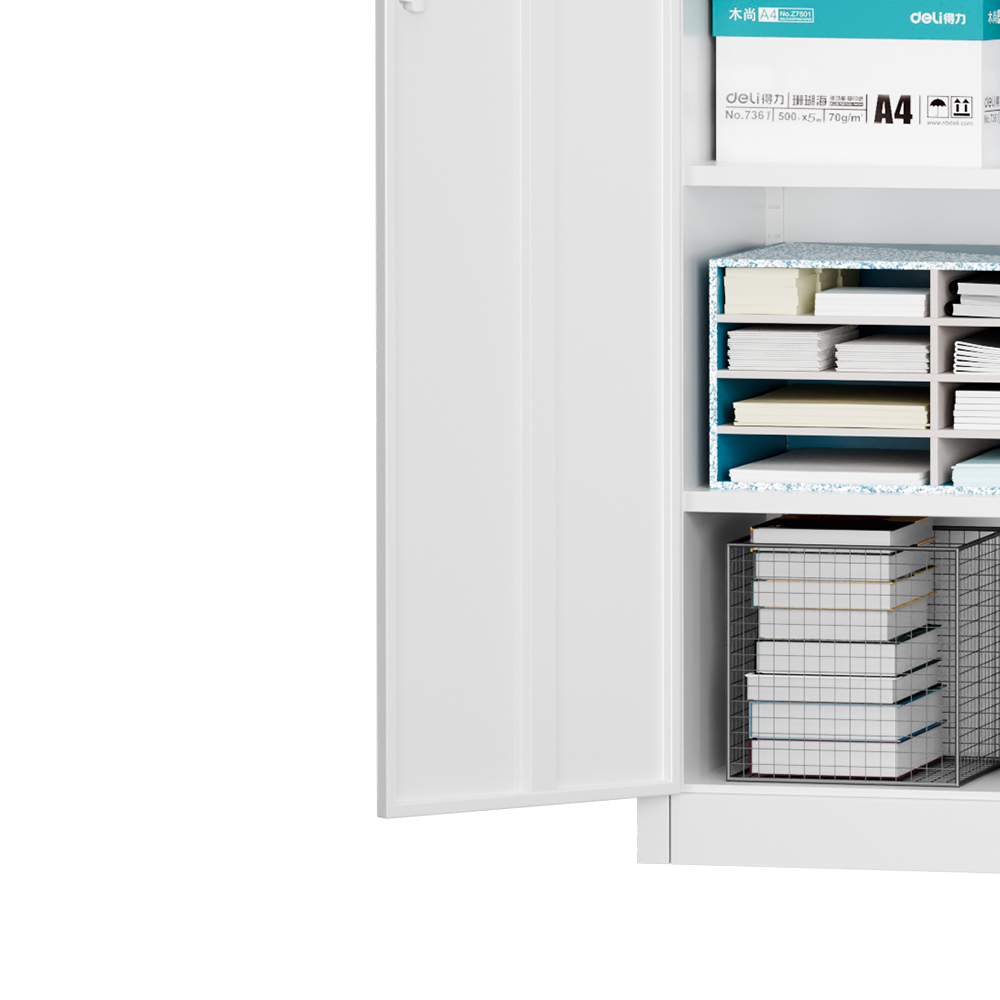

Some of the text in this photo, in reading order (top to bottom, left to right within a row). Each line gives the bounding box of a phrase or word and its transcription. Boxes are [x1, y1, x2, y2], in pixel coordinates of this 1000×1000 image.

[729, 7, 812, 22] 木尚 A4 No.Z7501
[910, 11, 966, 25] deli得力
[873, 94, 913, 125] A4
